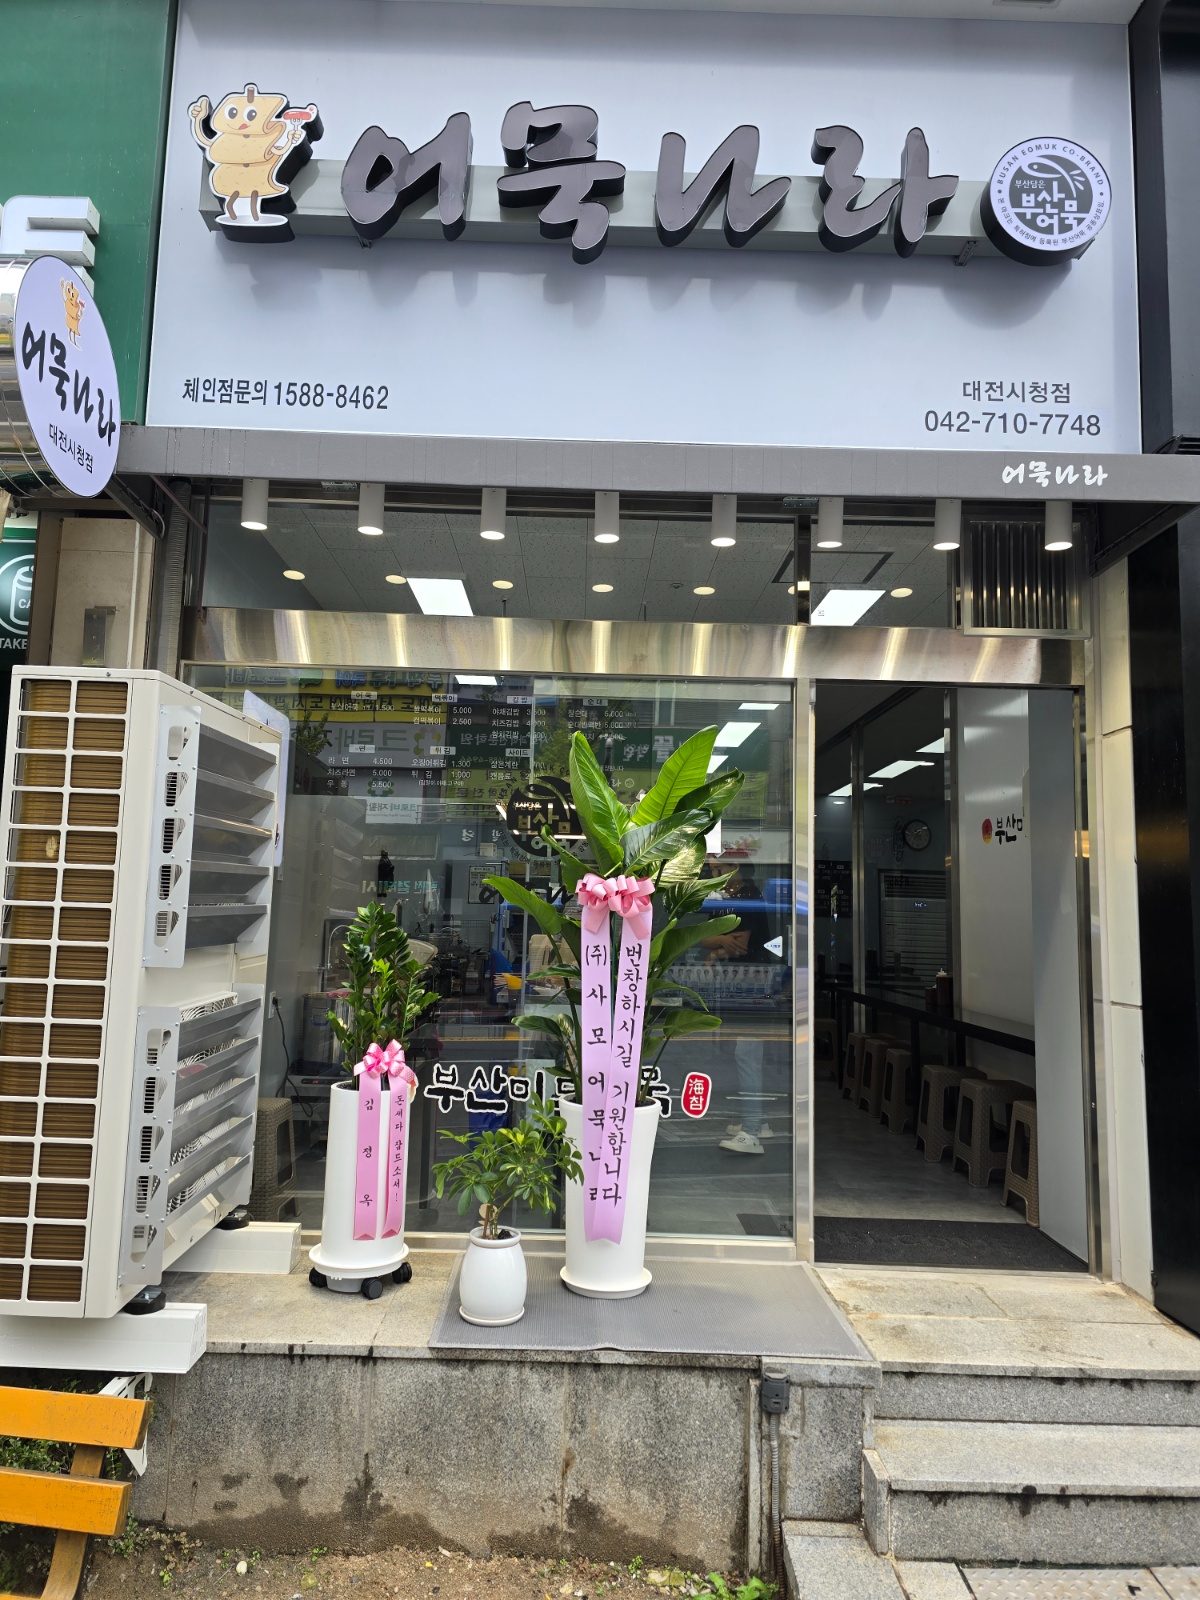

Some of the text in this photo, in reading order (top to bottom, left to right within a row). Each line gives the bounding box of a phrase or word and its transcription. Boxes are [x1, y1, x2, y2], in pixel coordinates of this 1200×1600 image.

[997, 143, 1104, 185] BUSAN EOMUK CO-BRAND
[341, 101, 959, 262] 어묵나라
[1014, 180, 1046, 189] 부산담은
[1011, 181, 1066, 219] 부산
[1036, 200, 1090, 235] 어묵
[1062, 230, 1087, 244] 부산어묵
[22, 321, 117, 447] 어묵나라
[182, 377, 389, 410] 체인점문의 1588-8462
[962, 380, 1071, 404] 대전시청점
[925, 411, 1101, 436] 042-710-7748
[48, 422, 94, 474] 대전시청점
[1002, 460, 1109, 487] 어묵나라
[452, 706, 472, 714] 5.000
[492, 707, 546, 716] 야채김밥 3500
[491, 719, 520, 727] 치즈김밥
[326, 768, 392, 777] 치즈라면 5.000
[372, 757, 393, 765] 4.500
[451, 760, 471, 768] 1.300
[451, 771, 471, 779] 1.000
[602, 943, 643, 1208] 번창하시길 기원합니다
